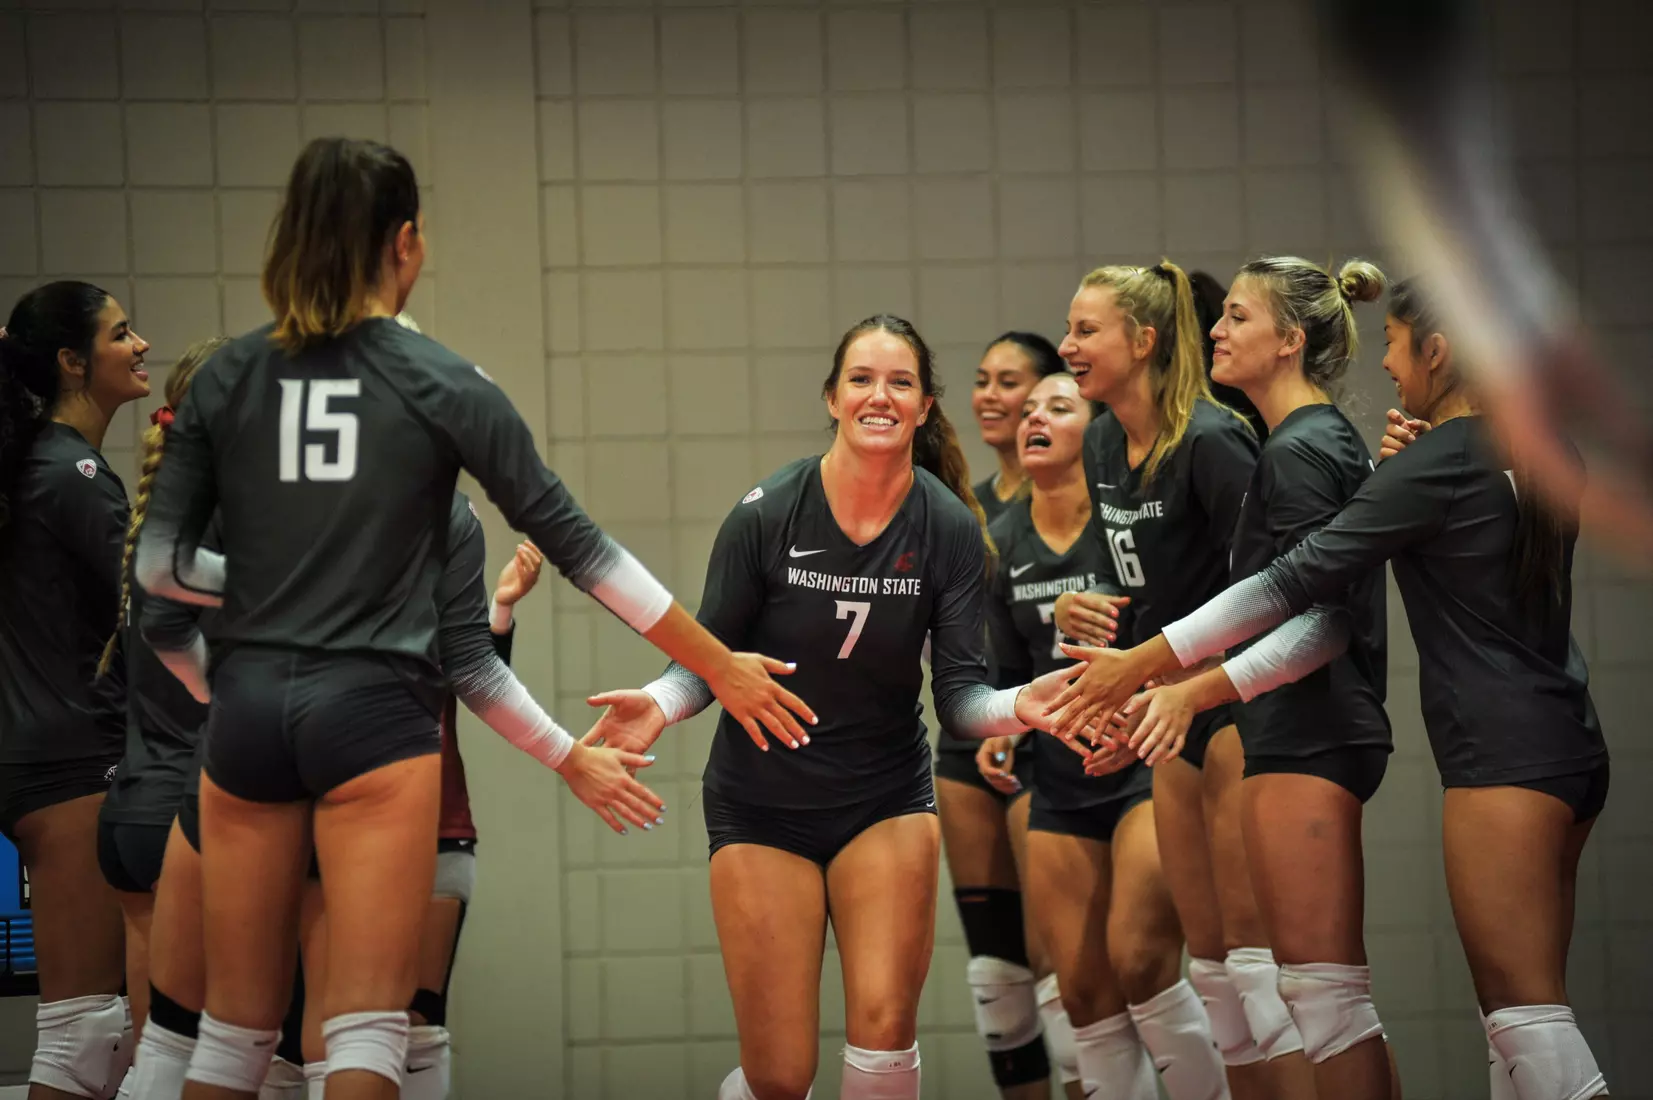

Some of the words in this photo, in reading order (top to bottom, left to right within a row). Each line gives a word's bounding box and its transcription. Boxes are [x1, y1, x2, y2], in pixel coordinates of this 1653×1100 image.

[277, 378, 361, 482] 15
[788, 567, 879, 595] WASHINGTON
[882, 578, 921, 595] STATE
[1105, 527, 1146, 587] 16
[1012, 575, 1086, 602] WASHINGTON
[834, 599, 871, 660] 7
